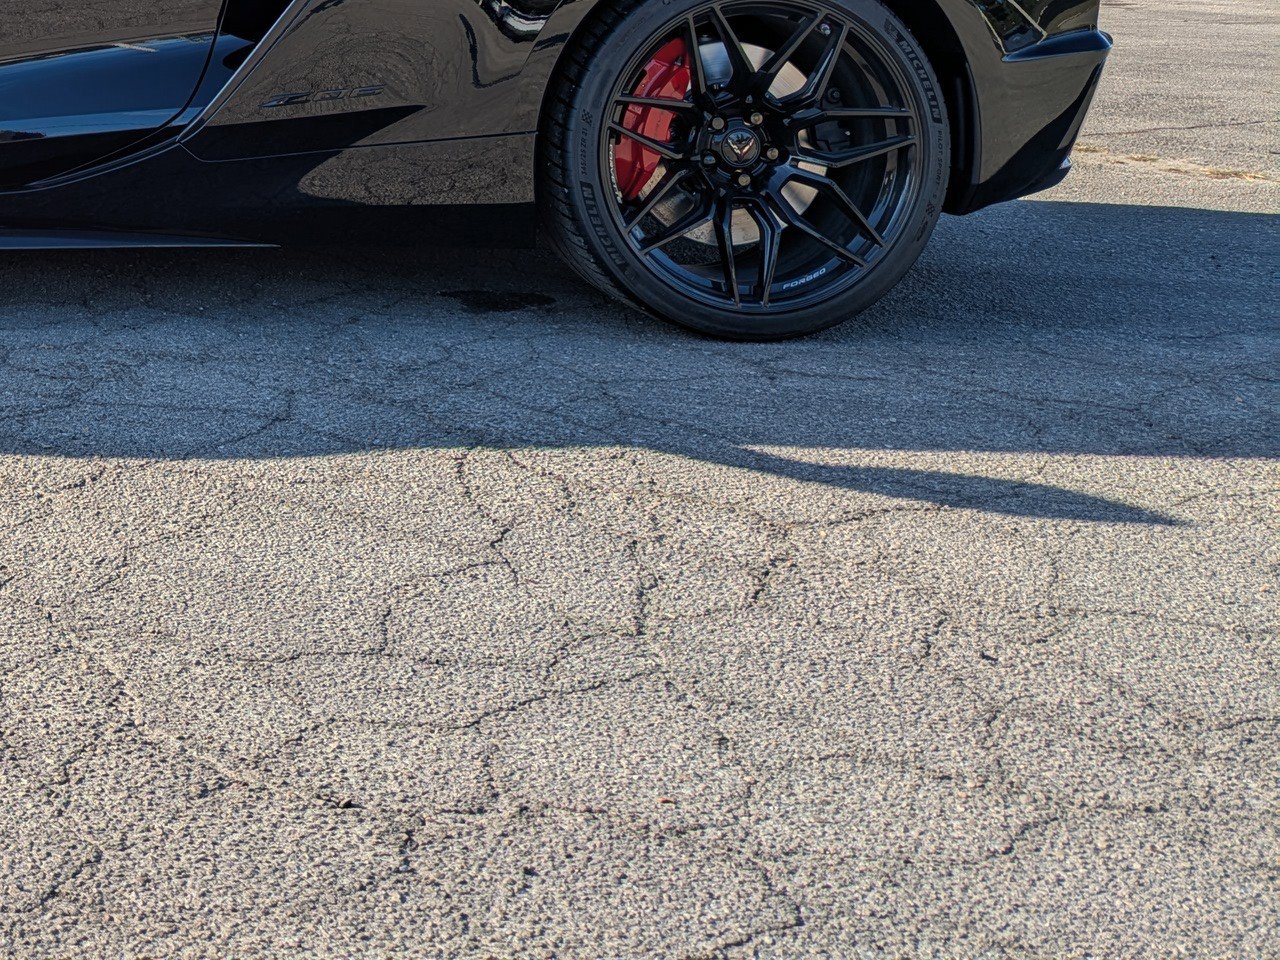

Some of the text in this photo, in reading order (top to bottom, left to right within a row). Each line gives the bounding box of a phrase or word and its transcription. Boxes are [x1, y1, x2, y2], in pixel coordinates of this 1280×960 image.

[899, 40, 941, 119] MICHELIN
[582, 186, 626, 266] MICHELIN
[782, 266, 827, 290] FORGED
